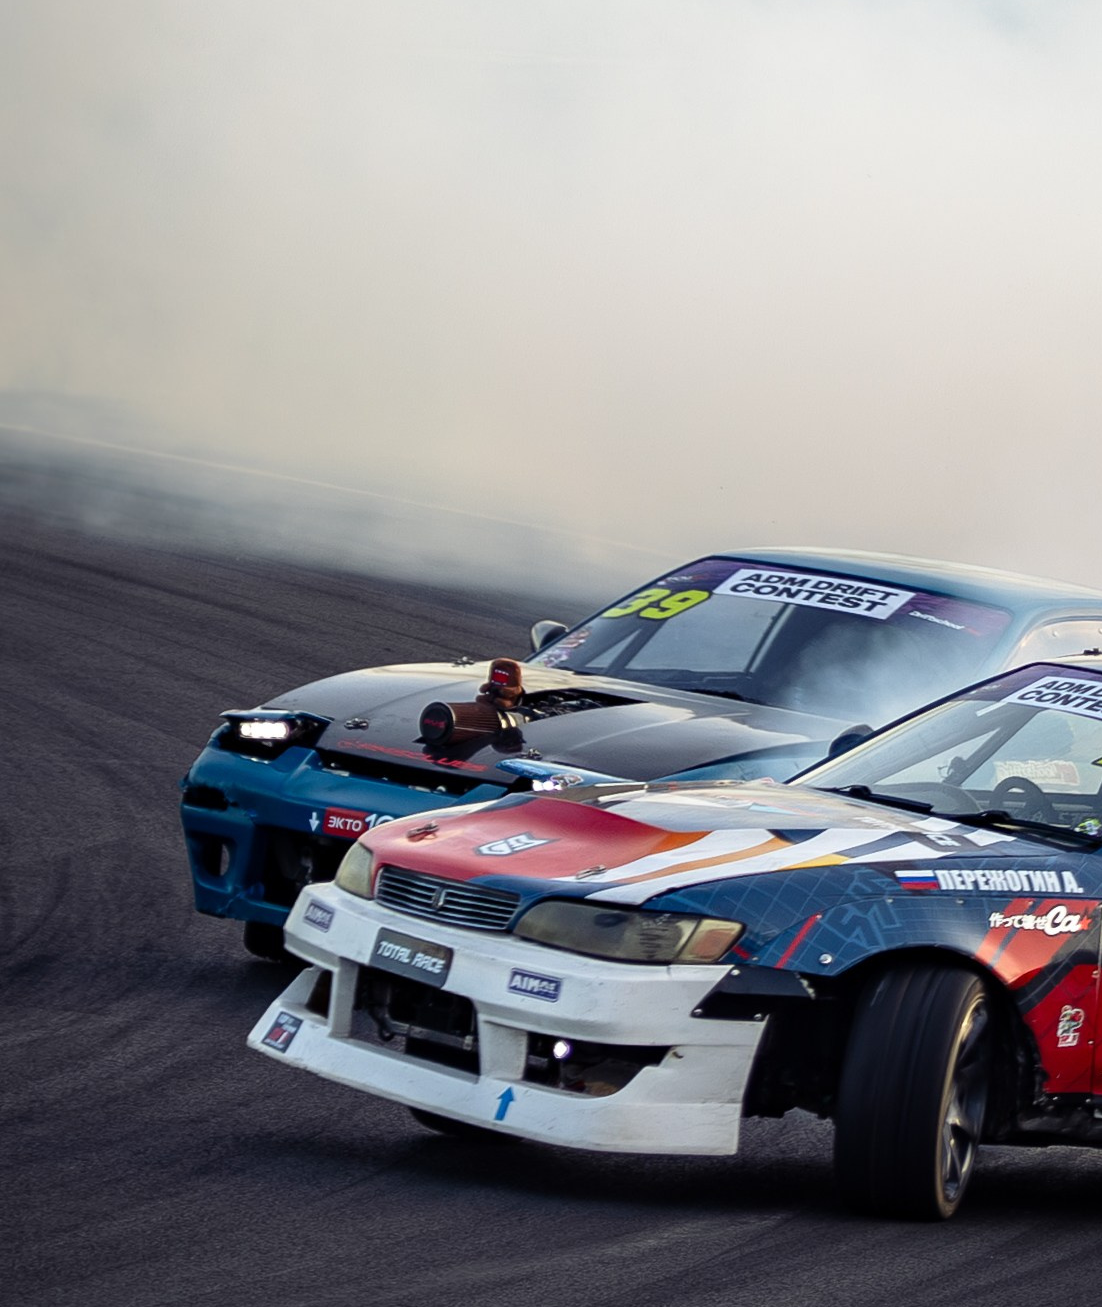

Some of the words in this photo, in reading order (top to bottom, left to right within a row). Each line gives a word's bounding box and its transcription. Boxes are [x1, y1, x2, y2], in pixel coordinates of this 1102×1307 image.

[730, 582, 887, 612] CONTEST
[741, 573, 810, 591] ADM
[806, 580, 899, 603] DRIFT
[601, 588, 710, 620] 39
[1040, 680, 1091, 698] ADM
[328, 816, 362, 832] ЭКТО
[934, 869, 1063, 893] ПЕРЕЖОГИН
[376, 940, 411, 963] TOTAL
[411, 951, 446, 974] RACE
